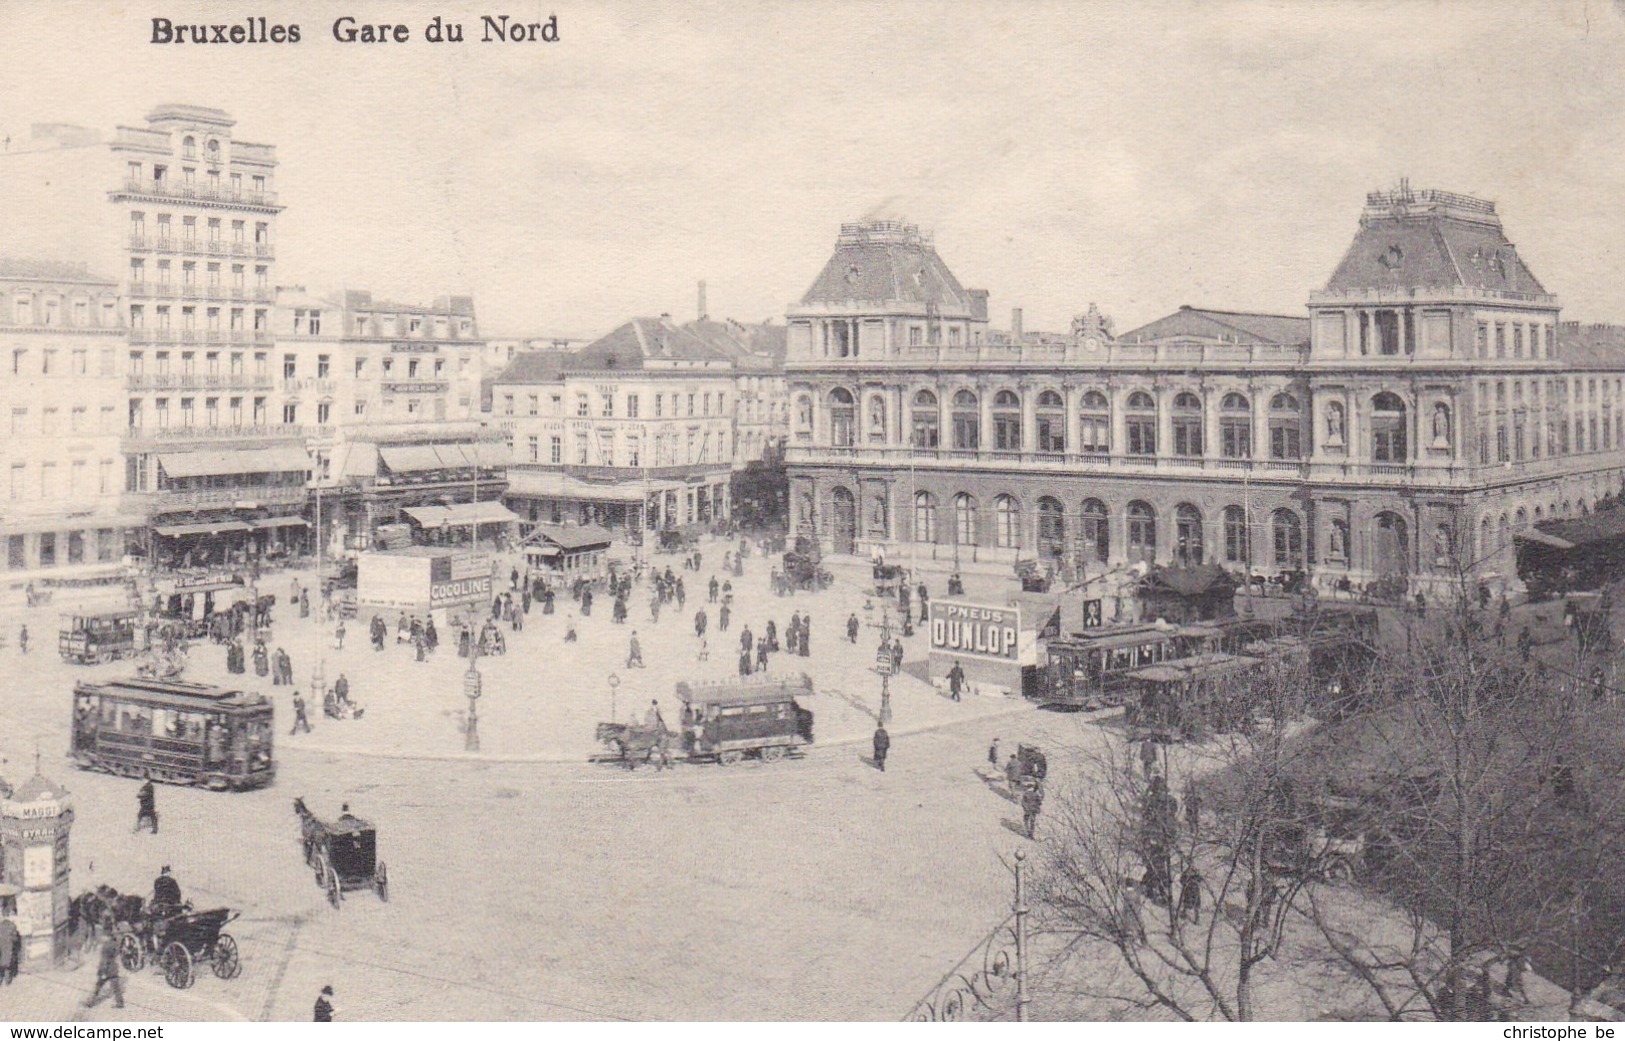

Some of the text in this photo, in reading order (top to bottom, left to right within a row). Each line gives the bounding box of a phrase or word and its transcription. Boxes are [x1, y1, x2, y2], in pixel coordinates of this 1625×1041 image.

[431, 578, 490, 599] COCOLINE
[947, 605, 1003, 622] PNEUS
[933, 617, 1016, 656] DUNLOP
[23, 807, 56, 816] MAGGI
